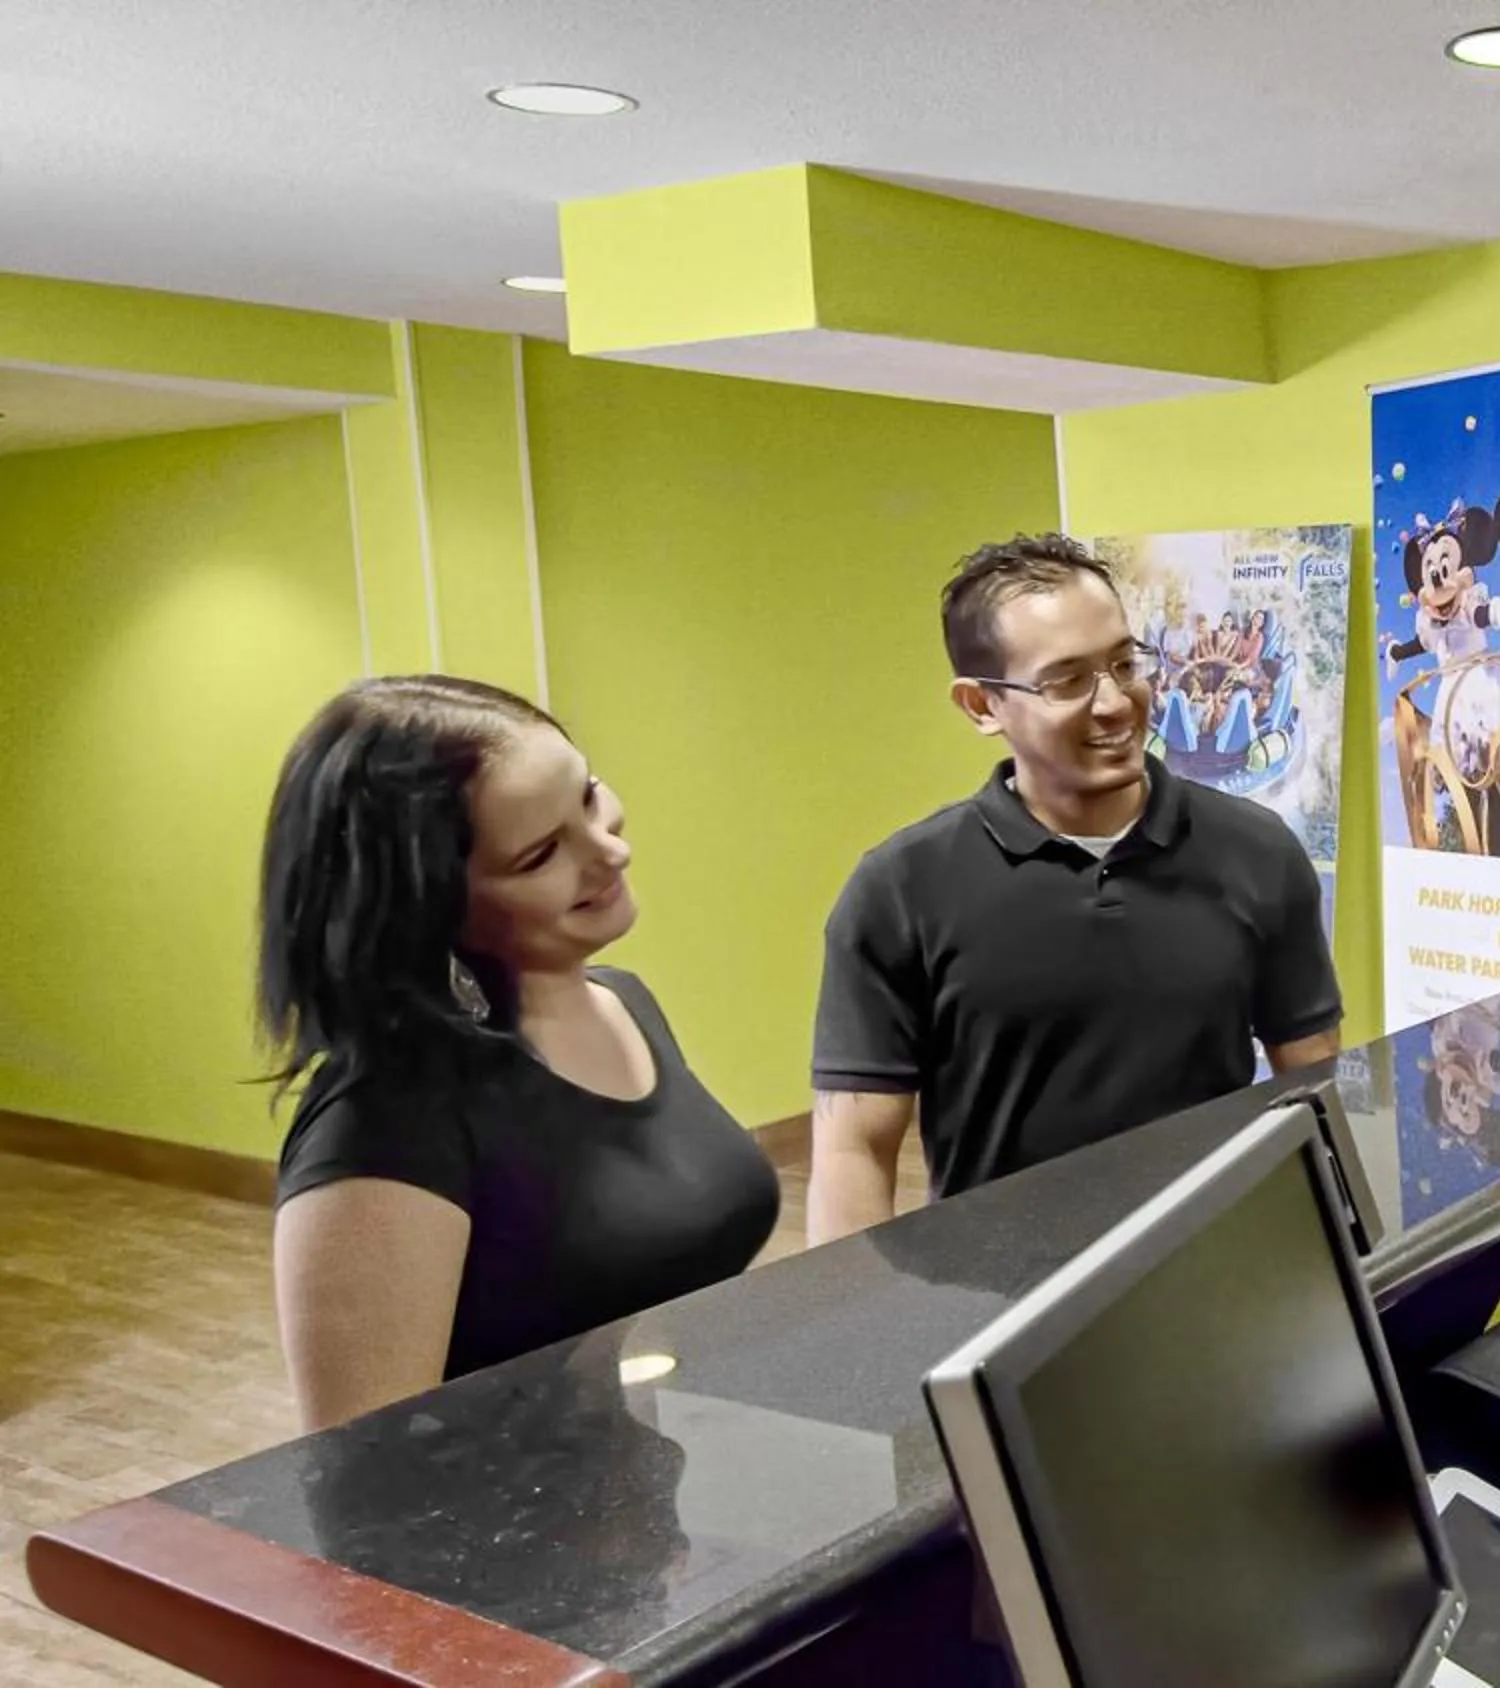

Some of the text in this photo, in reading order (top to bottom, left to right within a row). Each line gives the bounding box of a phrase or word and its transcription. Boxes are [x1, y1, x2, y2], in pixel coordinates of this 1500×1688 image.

[1233, 562, 1345, 580] INFINITY FALLS
[1418, 887, 1465, 912] PARK
[1409, 945, 1467, 974] WATER
